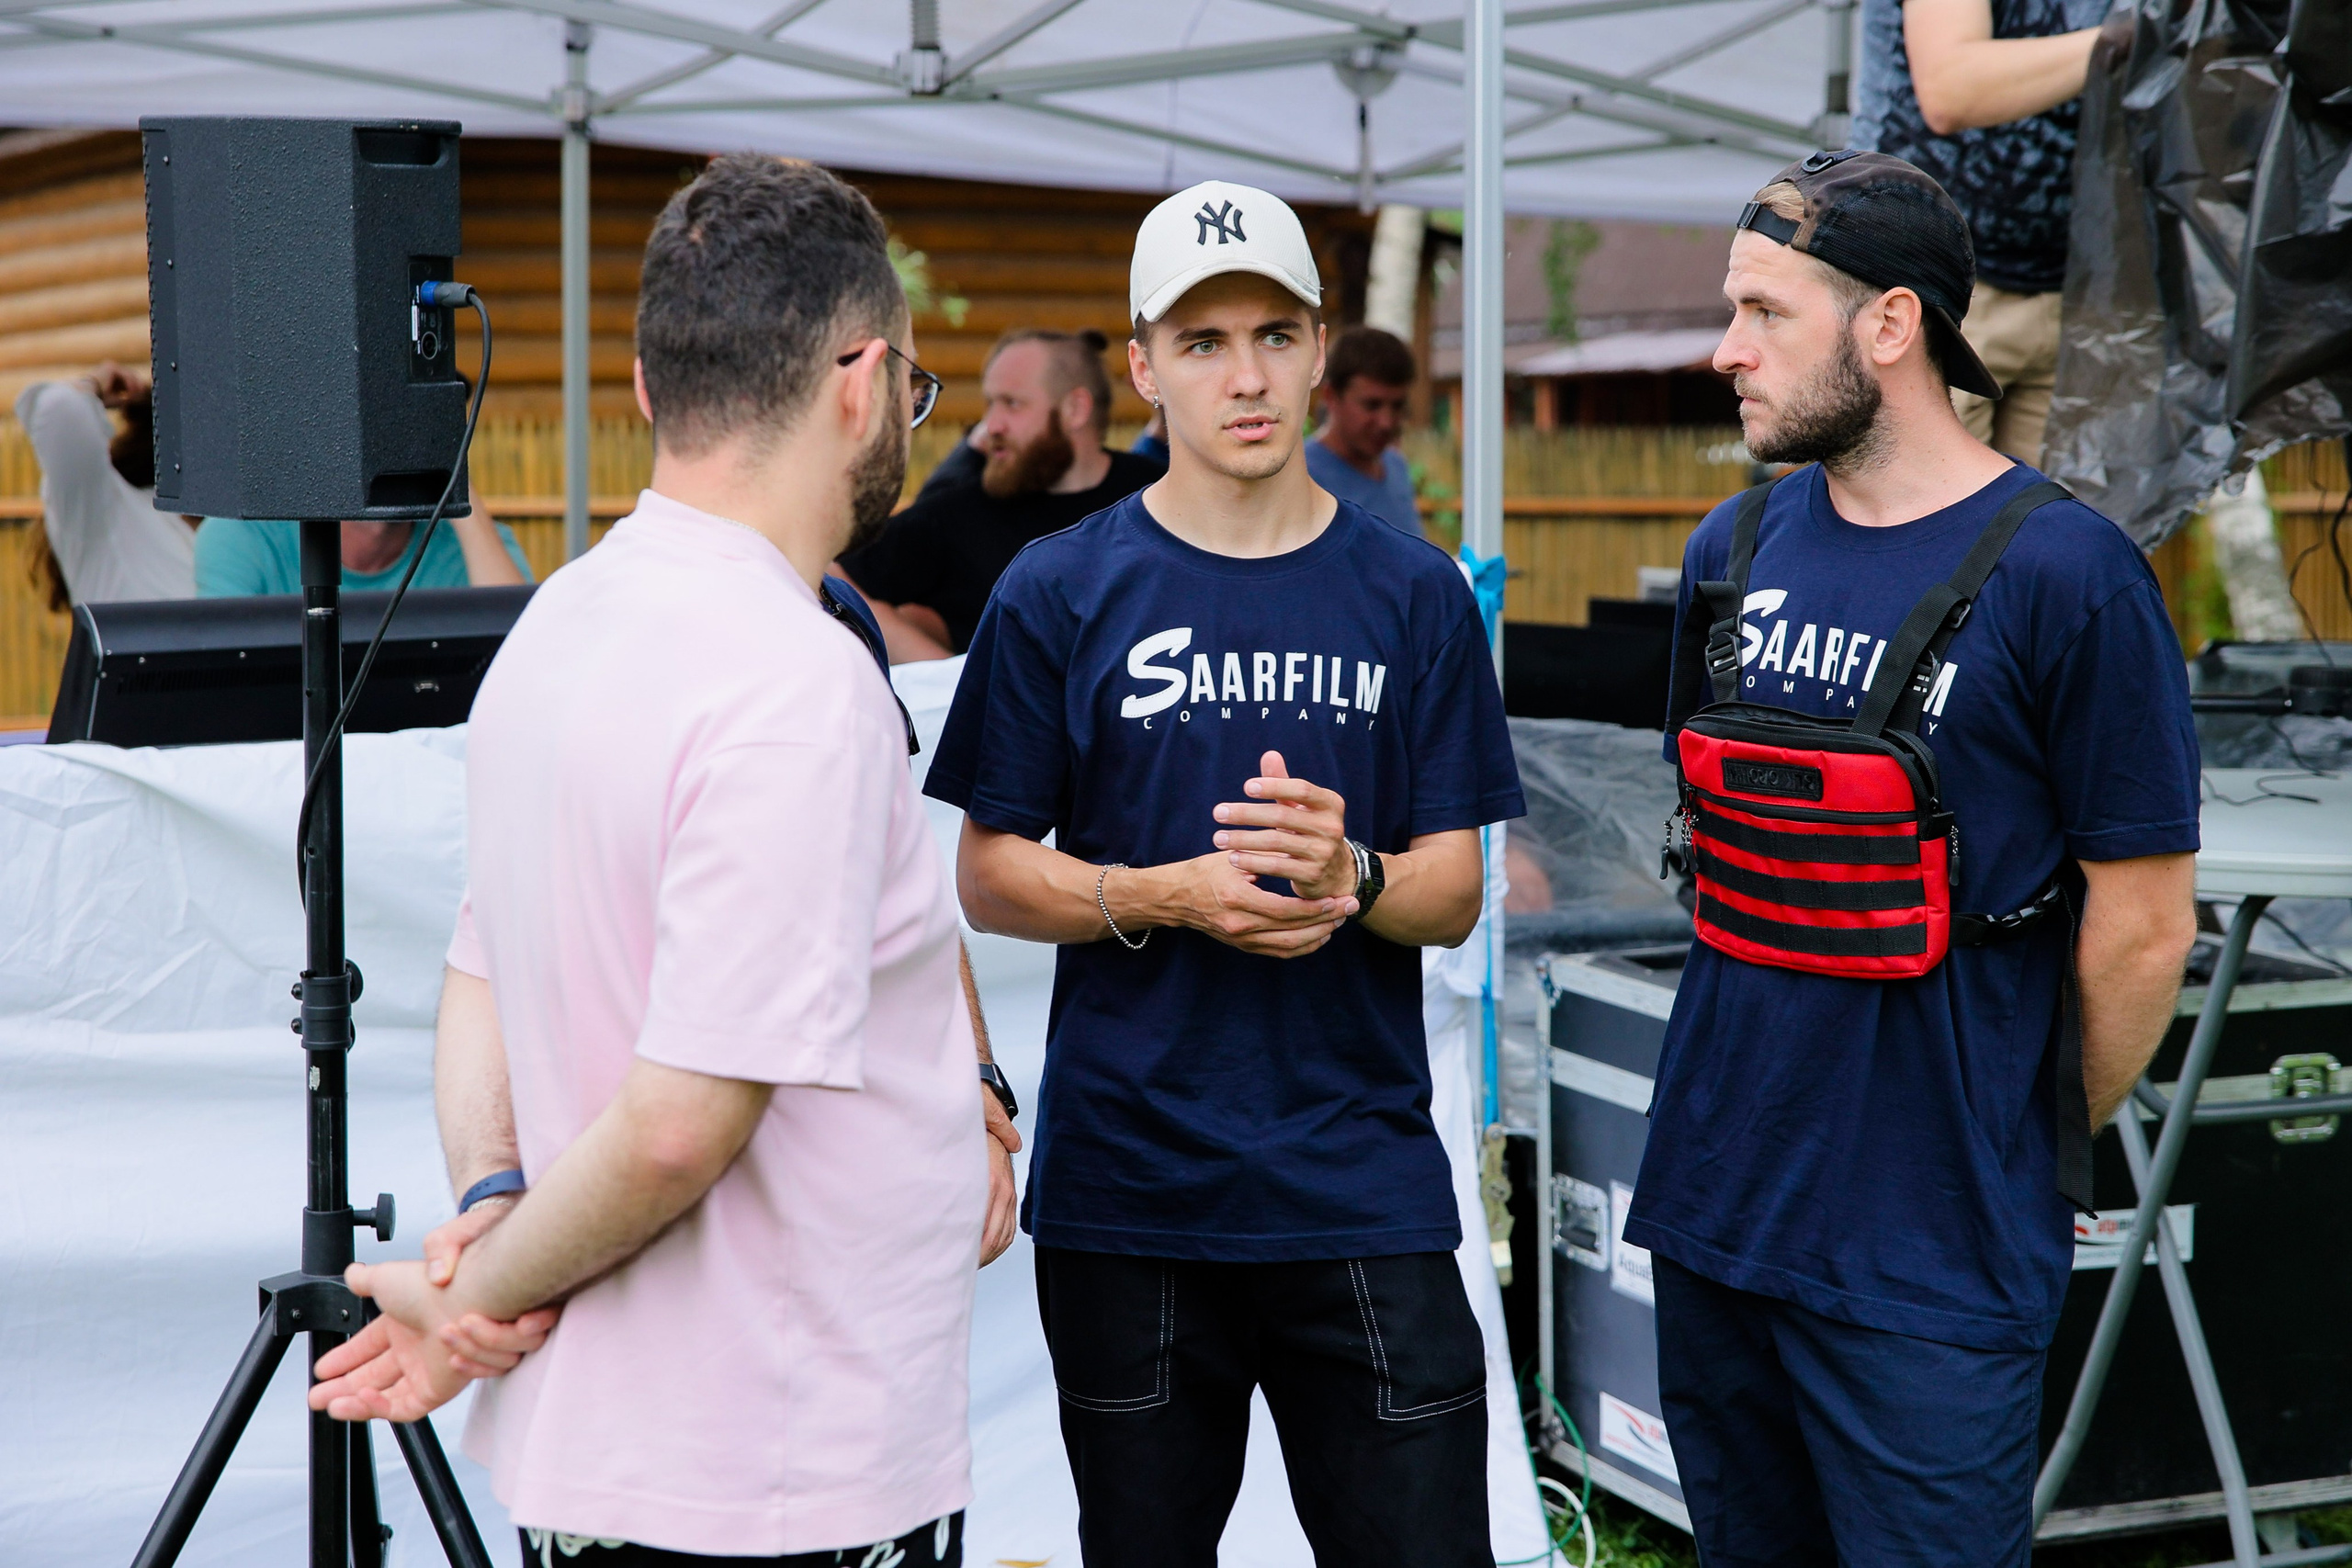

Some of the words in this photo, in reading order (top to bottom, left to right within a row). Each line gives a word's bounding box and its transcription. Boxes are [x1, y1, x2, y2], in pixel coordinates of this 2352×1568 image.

[1194, 199, 1247, 245] NY
[1120, 626, 1386, 718] SAARFILM
[1741, 589, 1958, 716] SAARFIM
[1143, 706, 1375, 731] COMPANY
[1746, 675, 1939, 735] OMPAY
